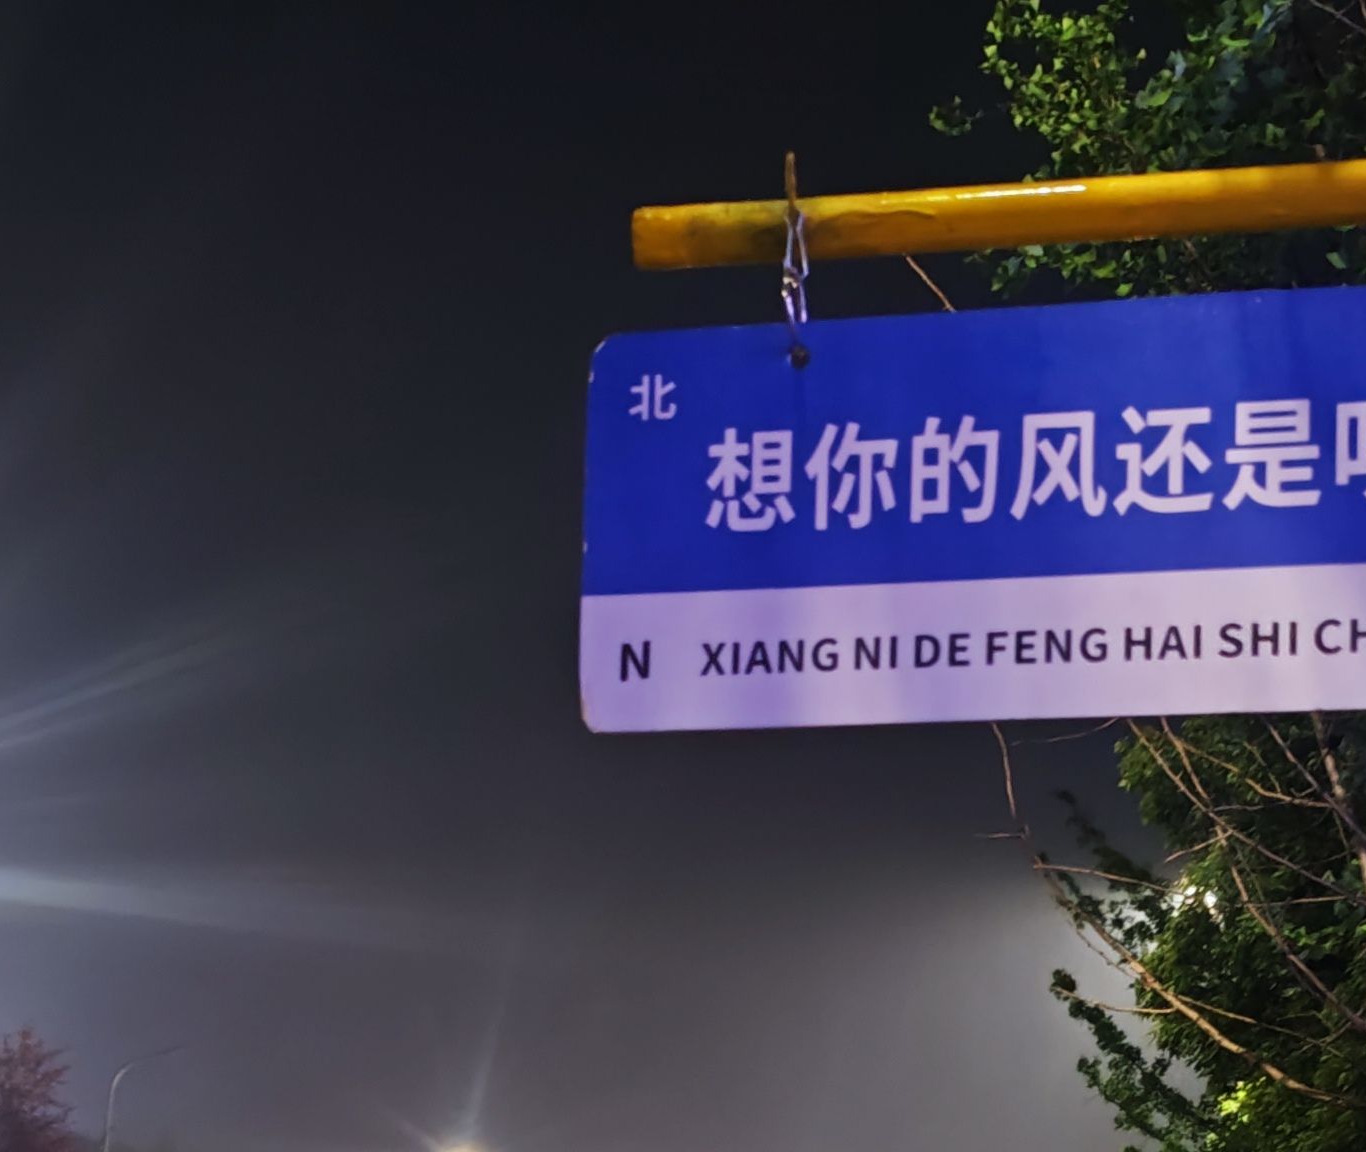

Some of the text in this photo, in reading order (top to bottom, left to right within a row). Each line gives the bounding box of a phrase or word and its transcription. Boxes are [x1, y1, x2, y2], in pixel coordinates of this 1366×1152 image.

[629, 374, 677, 421] 北
[619, 640, 651, 681] N
[700, 638, 839, 676] XIANG
[853, 636, 898, 670] NI
[913, 633, 971, 668] DE
[985, 628, 1109, 665] FENG
[1123, 625, 1202, 661] HAI
[1217, 621, 1298, 658] SHI
